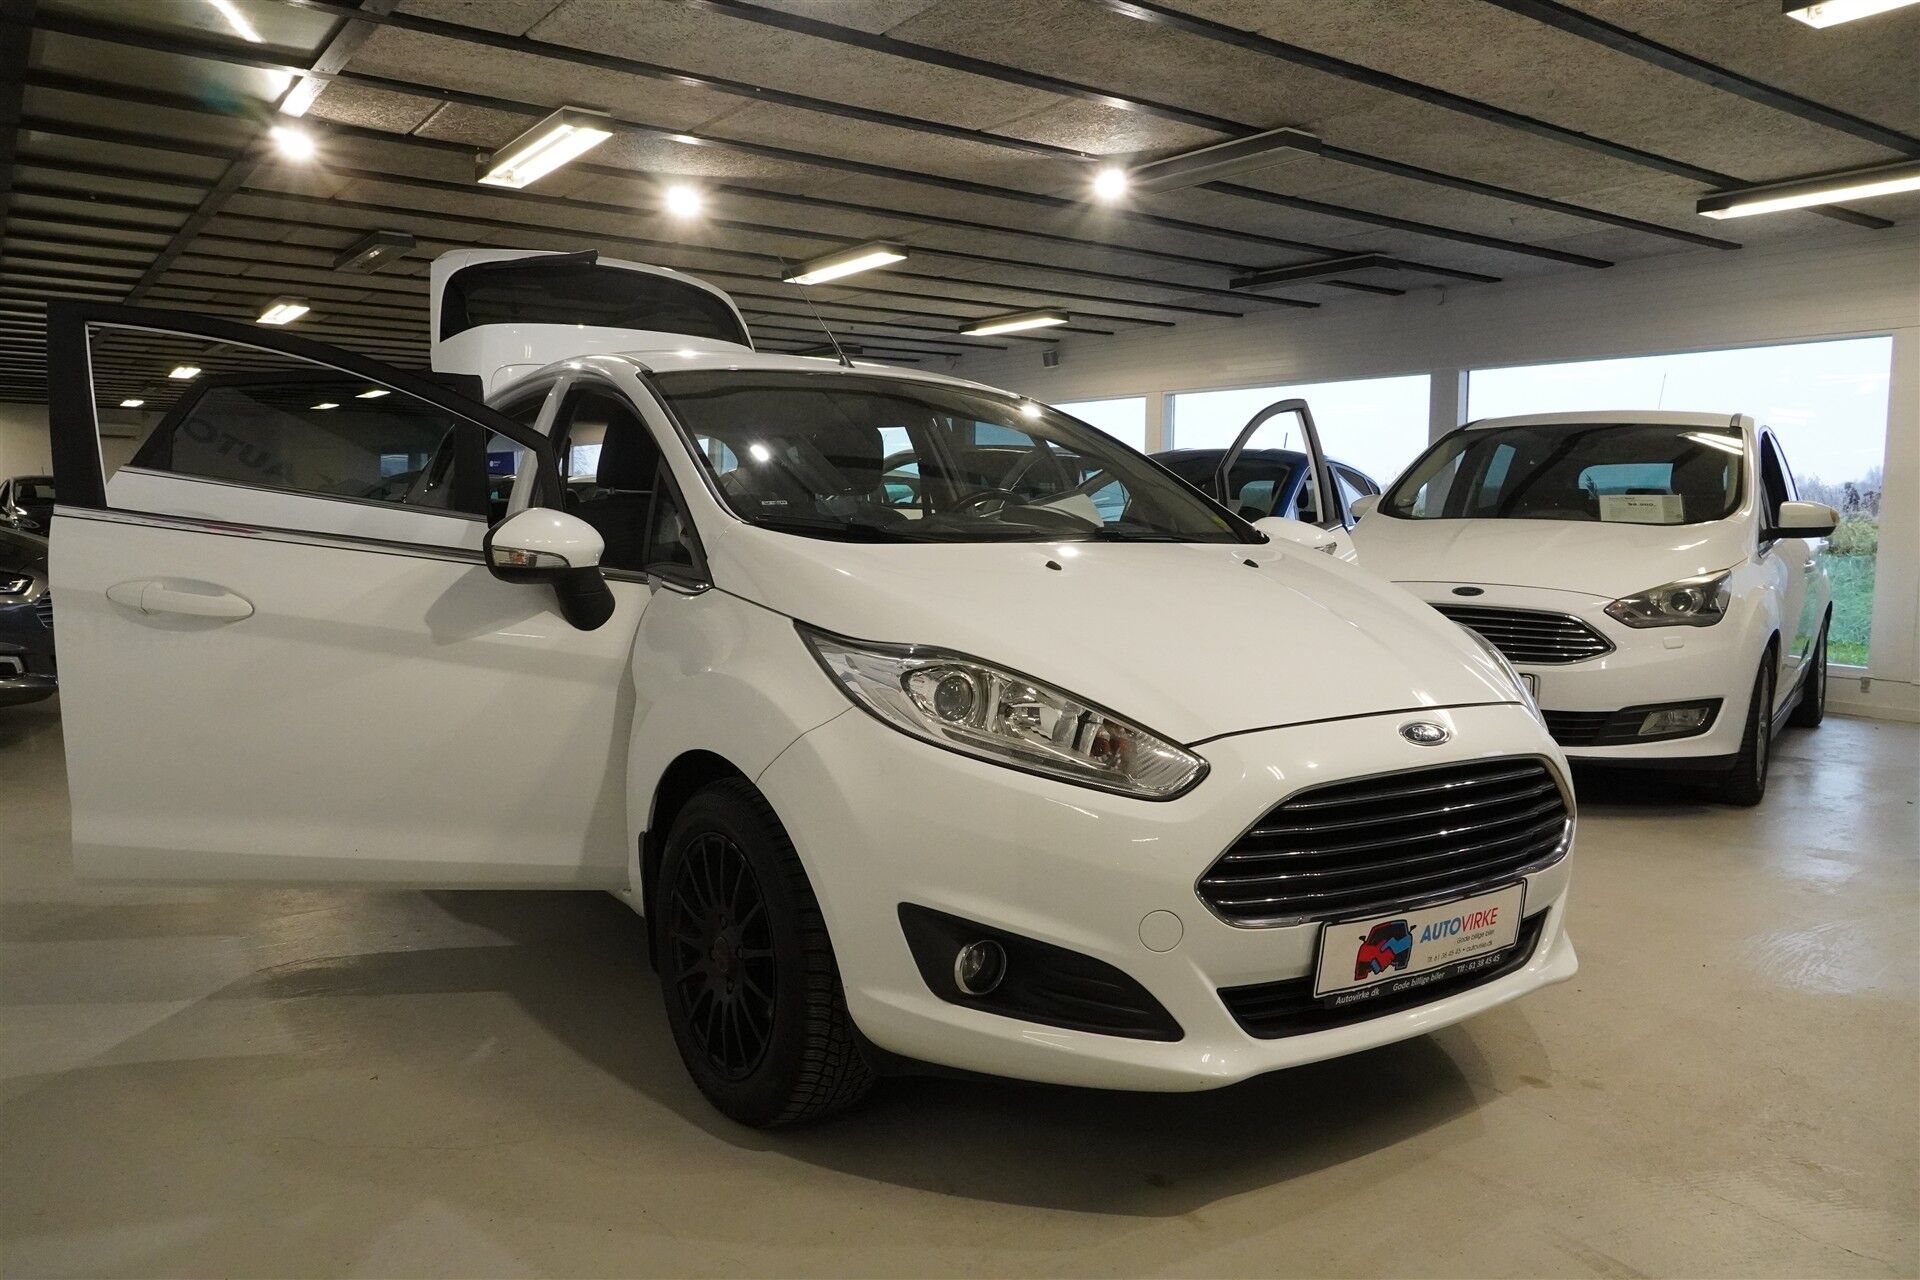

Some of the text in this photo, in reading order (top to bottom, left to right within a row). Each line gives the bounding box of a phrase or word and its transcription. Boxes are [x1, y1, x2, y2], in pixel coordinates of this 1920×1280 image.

[1420, 907, 1498, 943] AUTOVIRKE
[1468, 961, 1476, 970] 61
[1477, 959, 1485, 968] 38
[1485, 957, 1493, 965] 45
[1493, 954, 1500, 962] 45
[1392, 972, 1445, 991] Gode billige biler
